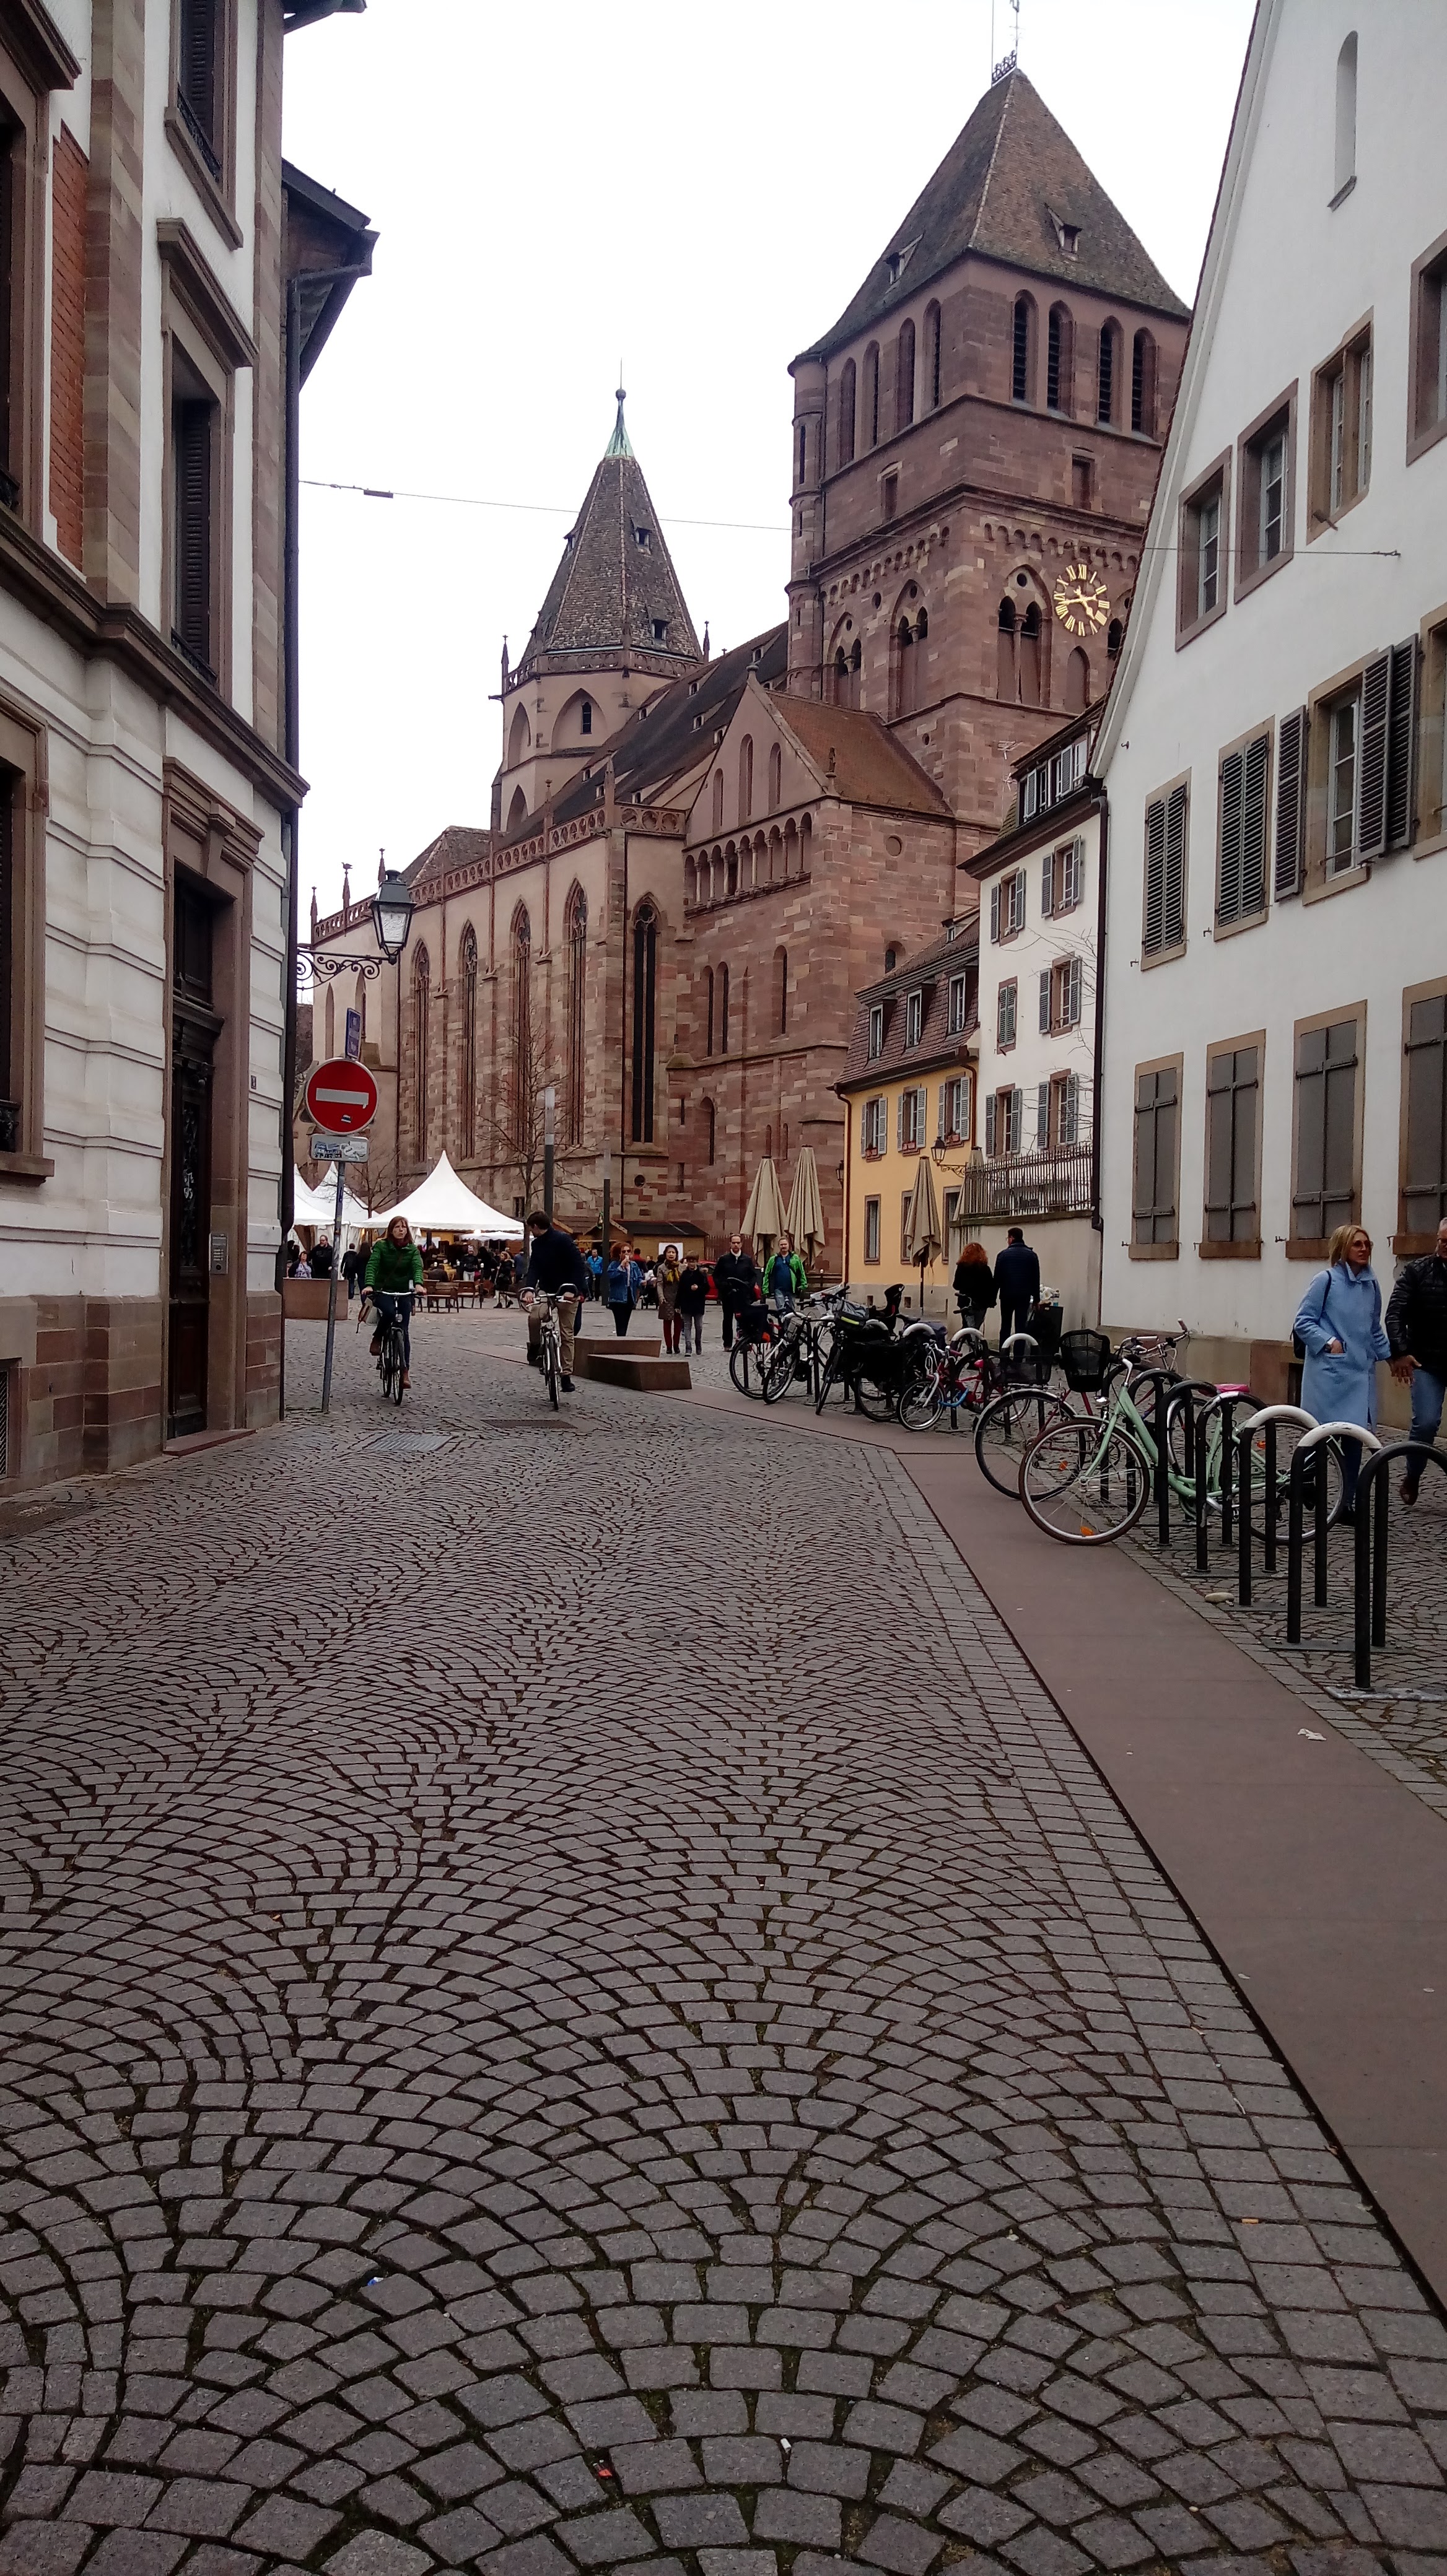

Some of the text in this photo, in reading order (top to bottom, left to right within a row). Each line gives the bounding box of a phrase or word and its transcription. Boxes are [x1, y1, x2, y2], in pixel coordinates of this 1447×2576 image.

[1078, 564, 1087, 580] XII
[1090, 571, 1097, 584] I
[1095, 585, 1108, 595] II
